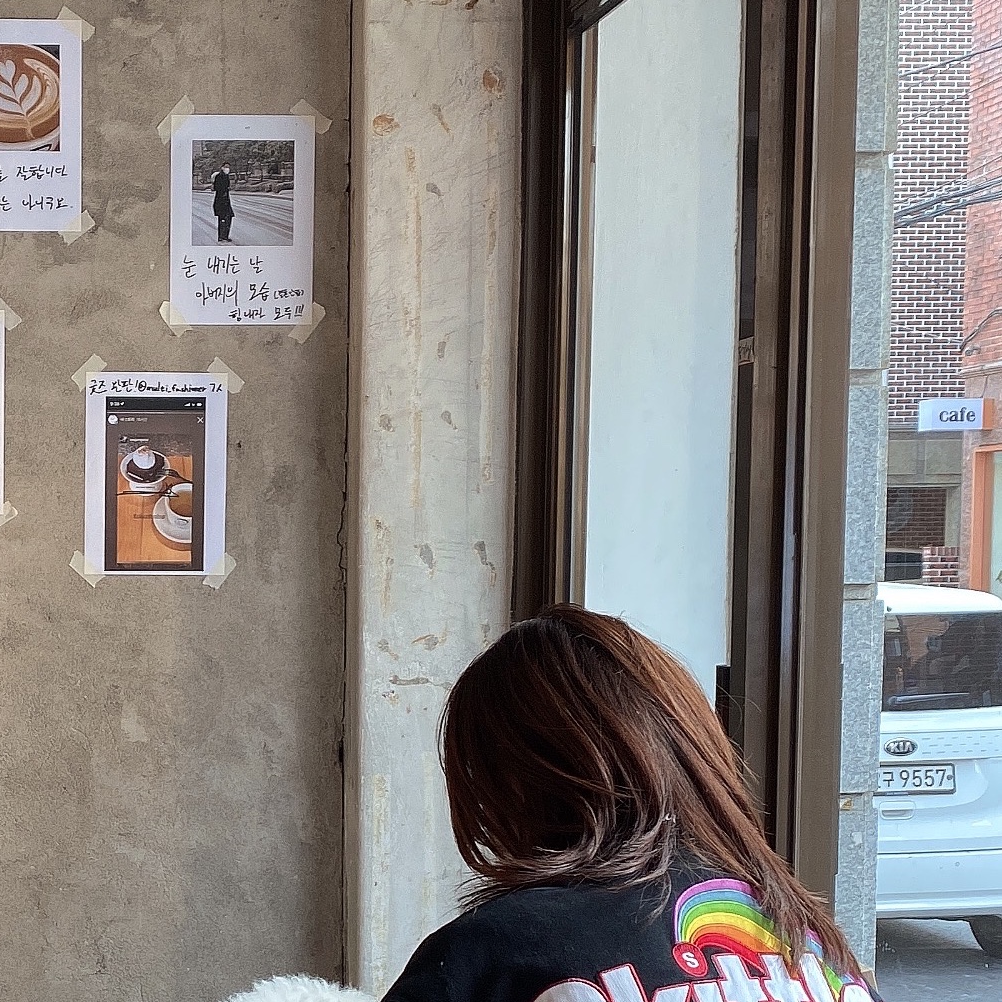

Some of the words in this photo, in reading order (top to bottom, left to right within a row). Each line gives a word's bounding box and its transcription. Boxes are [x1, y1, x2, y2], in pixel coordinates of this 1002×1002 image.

[181, 255, 197, 278] 눈
[207, 253, 241, 275] 내리는
[249, 255, 264, 274] 날
[195, 280, 239, 306] 아버지의
[248, 281, 270, 302] 모습
[939, 406, 976, 422] cafe
[887, 739, 914, 753] KIA
[899, 769, 947, 788] 9557
